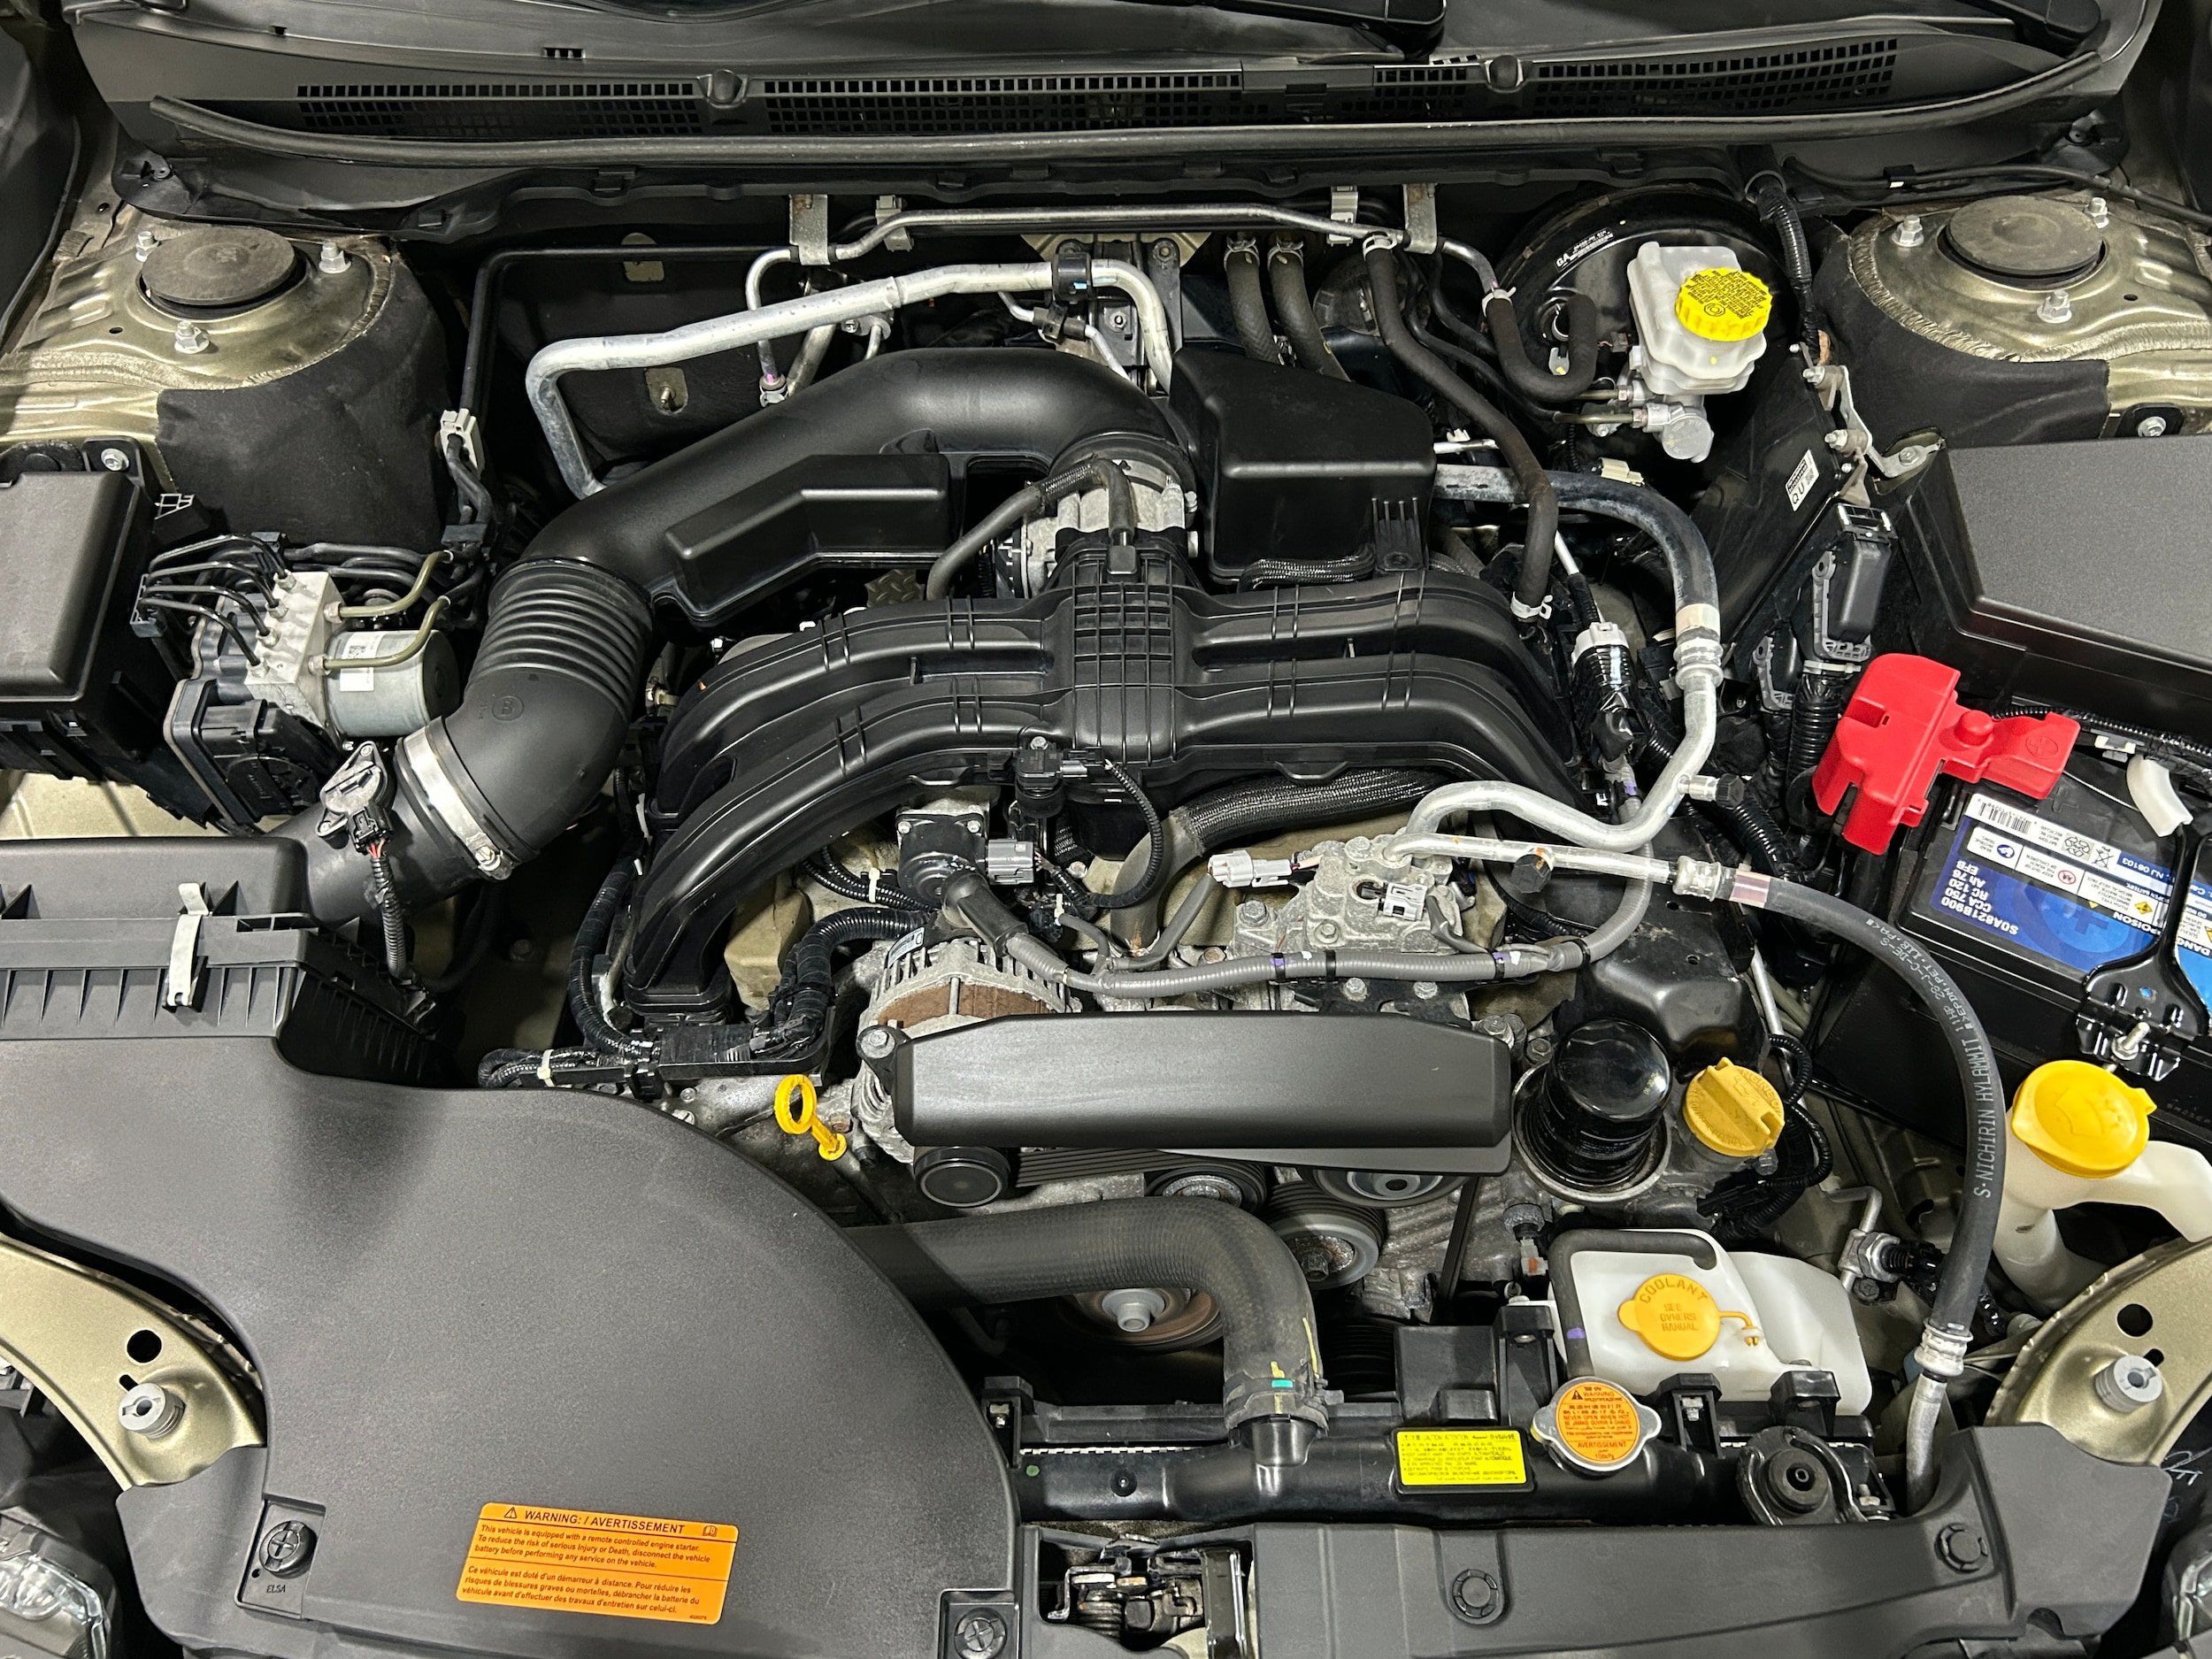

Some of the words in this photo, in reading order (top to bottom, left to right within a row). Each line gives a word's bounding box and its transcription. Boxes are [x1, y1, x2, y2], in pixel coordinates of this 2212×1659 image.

[1956, 860, 1979, 876] EFB
[1948, 879, 1969, 893] 120
[1969, 876, 1985, 888] Ah
[1945, 888, 1965, 903] 750
[1971, 888, 1990, 901] RC
[1969, 900, 1992, 913] CCA
[1640, 1278, 1709, 1304] COOLANT
[1663, 1302, 1682, 1311] SEE
[1662, 1322, 1699, 1331] MANUAL
[525, 1510, 581, 1524] WARNING:
[583, 1516, 588, 1525] /
[590, 1517, 685, 1533] AVERTISSEMENT
[498, 1526, 522, 1535] vehicle
[532, 1530, 565, 1540] equipped
[565, 1532, 580, 1540] with
[614, 1537, 649, 1547] controlled
[475, 1545, 499, 1555] battery
[501, 1547, 523, 1555] before
[525, 1550, 563, 1561] performing
[580, 1554, 604, 1563] service
[630, 1559, 657, 1568] vehicle.
[488, 1535, 511, 1544] reduce
[609, 1547, 631, 1556] Death,
[632, 1549, 671, 1559] disconnect
[686, 1554, 710, 1563] vehicle
[480, 1567, 509, 1576] véhicule
[557, 1574, 593, 1585] démarreur
[602, 1578, 634, 1588] distance.
[635, 1581, 652, 1590] Pour
[654, 1584, 679, 1593] réduire
[465, 1577, 491, 1586] risques
[503, 1580, 538, 1589] blessures
[540, 1585, 564, 1594] graves
[576, 1587, 611, 1597] mortelles,
[613, 1591, 652, 1601] débrancher
[662, 1595, 688, 1604] batterie
[463, 1587, 492, 1596] véhicule
[597, 1599, 634, 1609] d'entretien
[649, 1603, 677, 1613] celui-ci.
